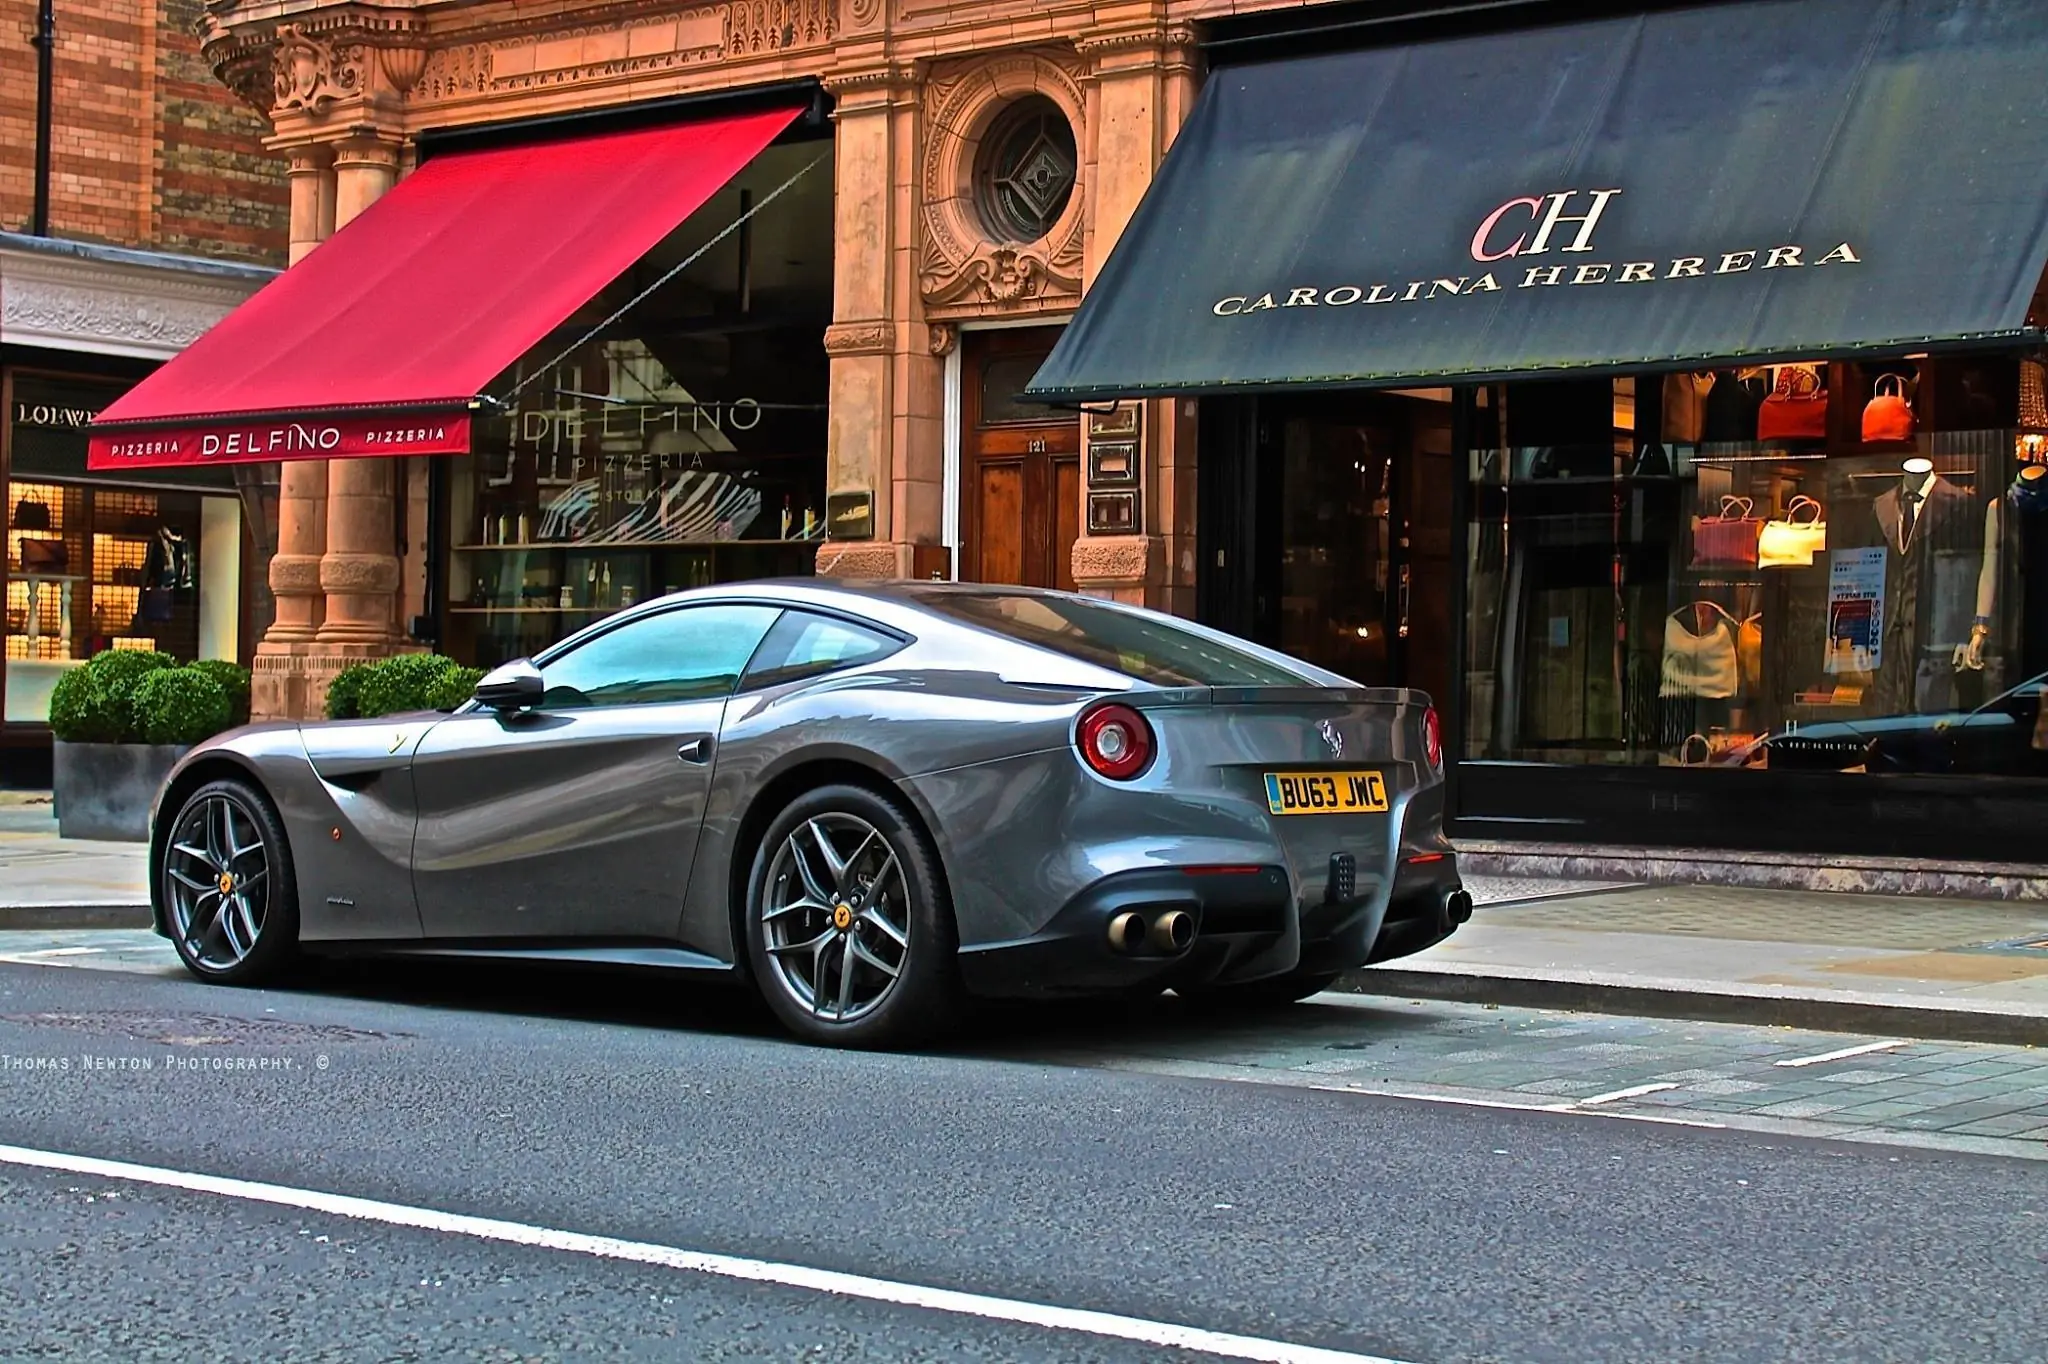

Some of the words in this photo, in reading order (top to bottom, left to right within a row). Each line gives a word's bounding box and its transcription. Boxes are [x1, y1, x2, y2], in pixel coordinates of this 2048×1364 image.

[1470, 188, 1622, 263] CH
[1212, 272, 1502, 316] CAROLINA
[1518, 242, 1861, 288] HERRERA
[524, 398, 761, 440] DELFINO
[112, 441, 179, 456] PIZZERIA
[202, 423, 340, 456] DELFINO
[366, 427, 445, 443] PIZZERIA
[1029, 440, 1045, 452] 121
[576, 451, 703, 471] PIZZERIA
[1280, 777, 1338, 809] BU63
[1345, 776, 1384, 807] JWC
